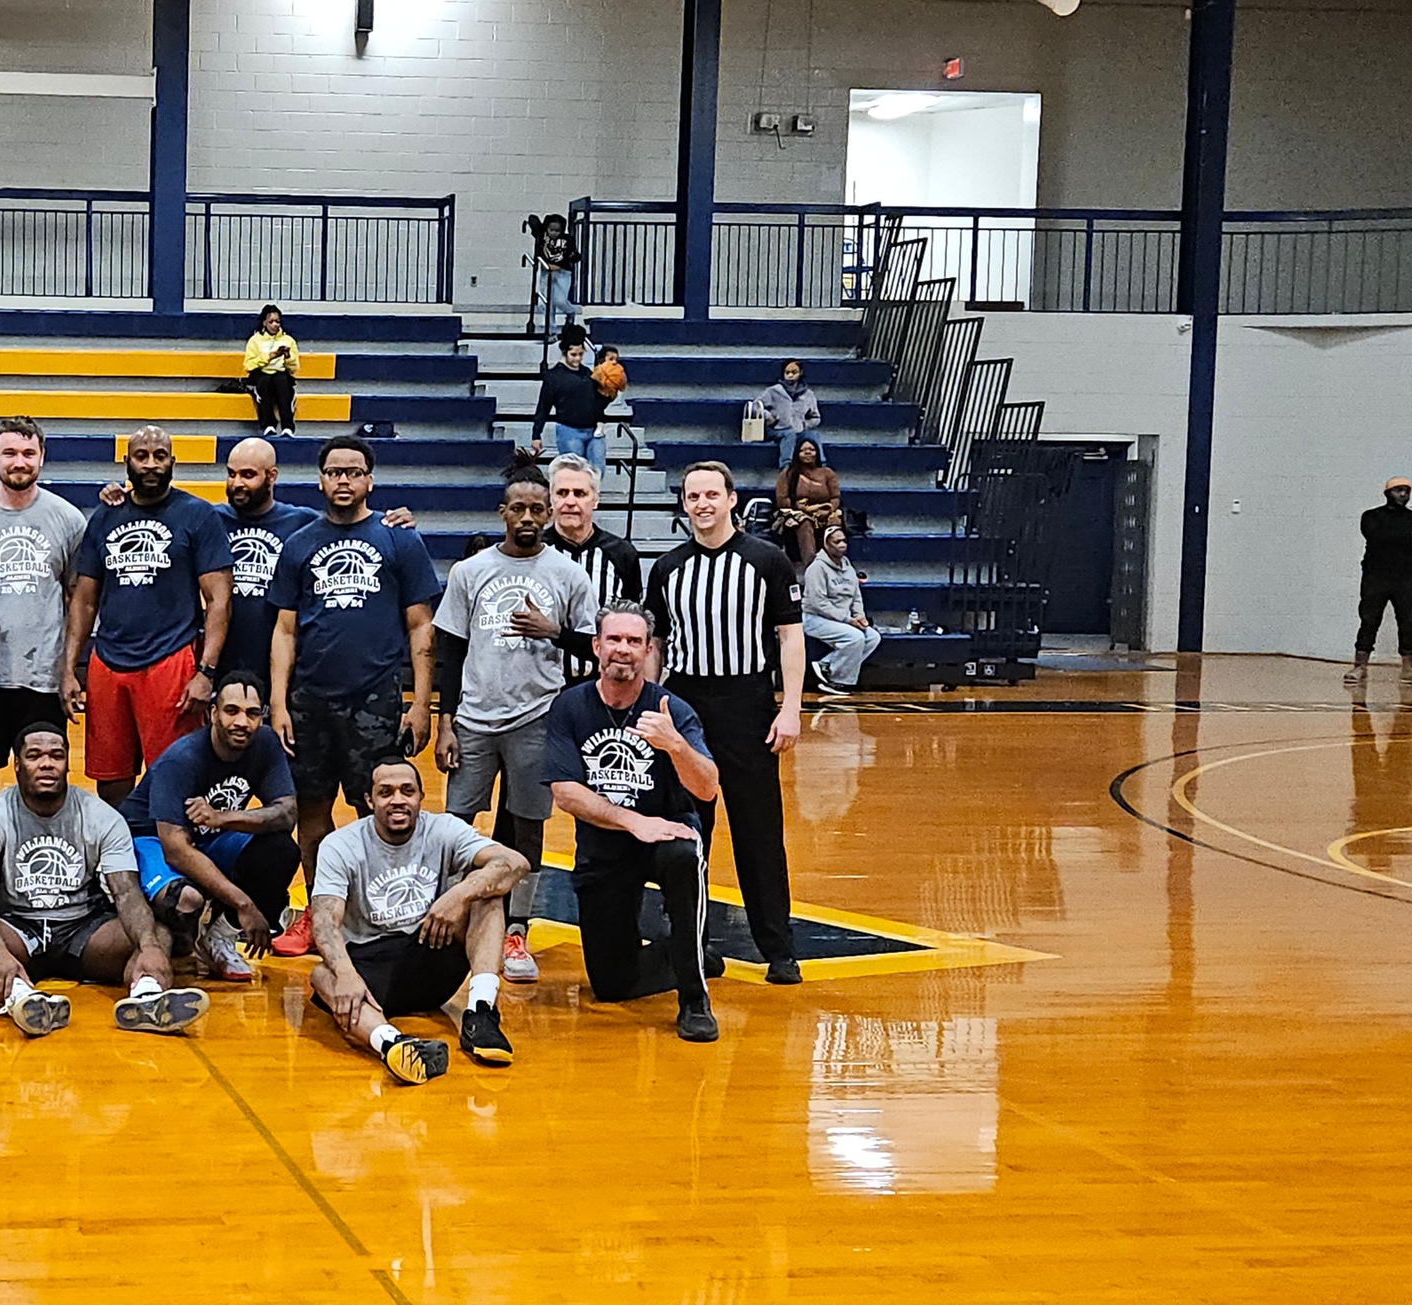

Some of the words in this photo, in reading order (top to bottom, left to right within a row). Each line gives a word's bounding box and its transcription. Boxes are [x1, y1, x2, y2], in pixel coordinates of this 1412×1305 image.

[106, 520, 173, 541] WILLIAMSON
[107, 553, 170, 566] BASKETBALL
[310, 539, 383, 566] WILLIAMSON
[1, 586, 13, 594] 20
[25, 585, 36, 593] 24
[119, 577, 131, 586] 20
[141, 576, 154, 585] 24
[315, 575, 379, 592] BASKETBALL
[251, 587, 265, 597] 24
[481, 575, 554, 606] WILLIAMSON
[325, 599, 337, 608] 20
[350, 599, 363, 608] 24
[493, 638, 506, 647] 20
[581, 728, 655, 759] WILLIAMSON
[623, 797, 636, 808] 24
[16, 836, 83, 863] WILLIAMSON
[367, 863, 438, 895] WILLIAON
[371, 901, 434, 922] BASKETBA
